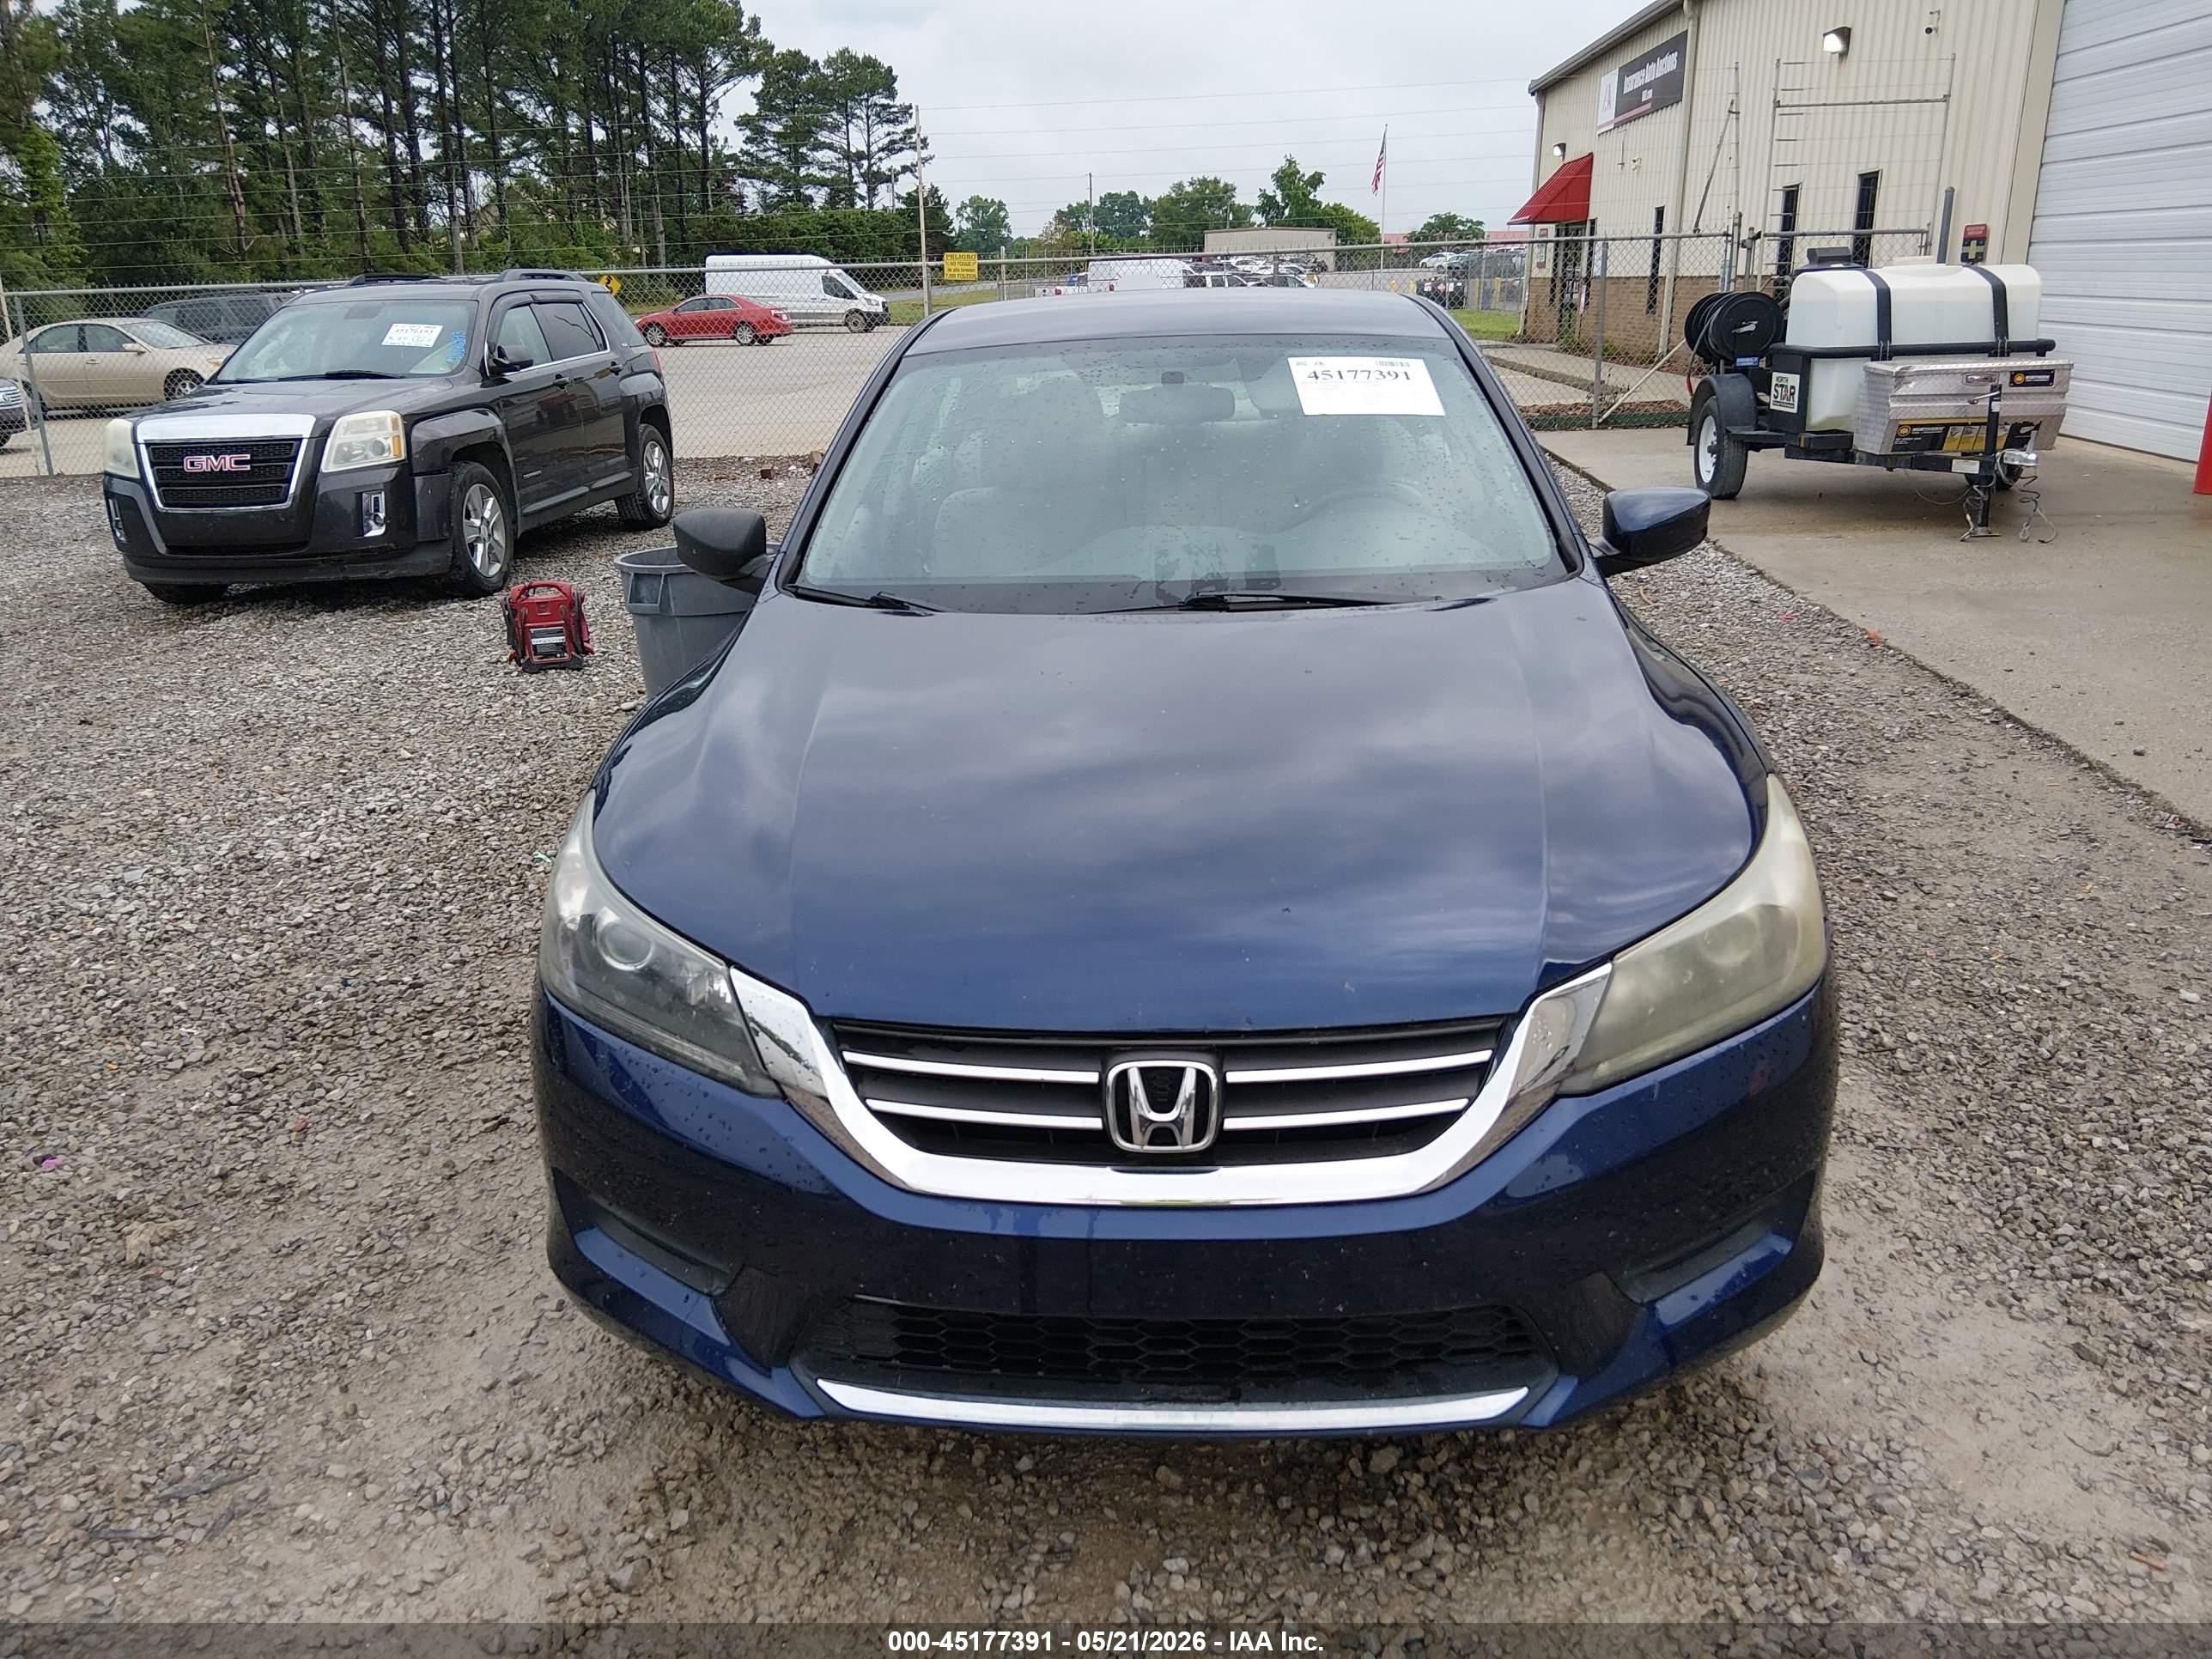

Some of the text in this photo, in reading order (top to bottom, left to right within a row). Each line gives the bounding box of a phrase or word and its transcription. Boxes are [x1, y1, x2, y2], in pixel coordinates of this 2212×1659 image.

[1307, 369, 1411, 381] 45177391
[1773, 383, 1796, 402] STAR
[183, 453, 251, 472] GMC
